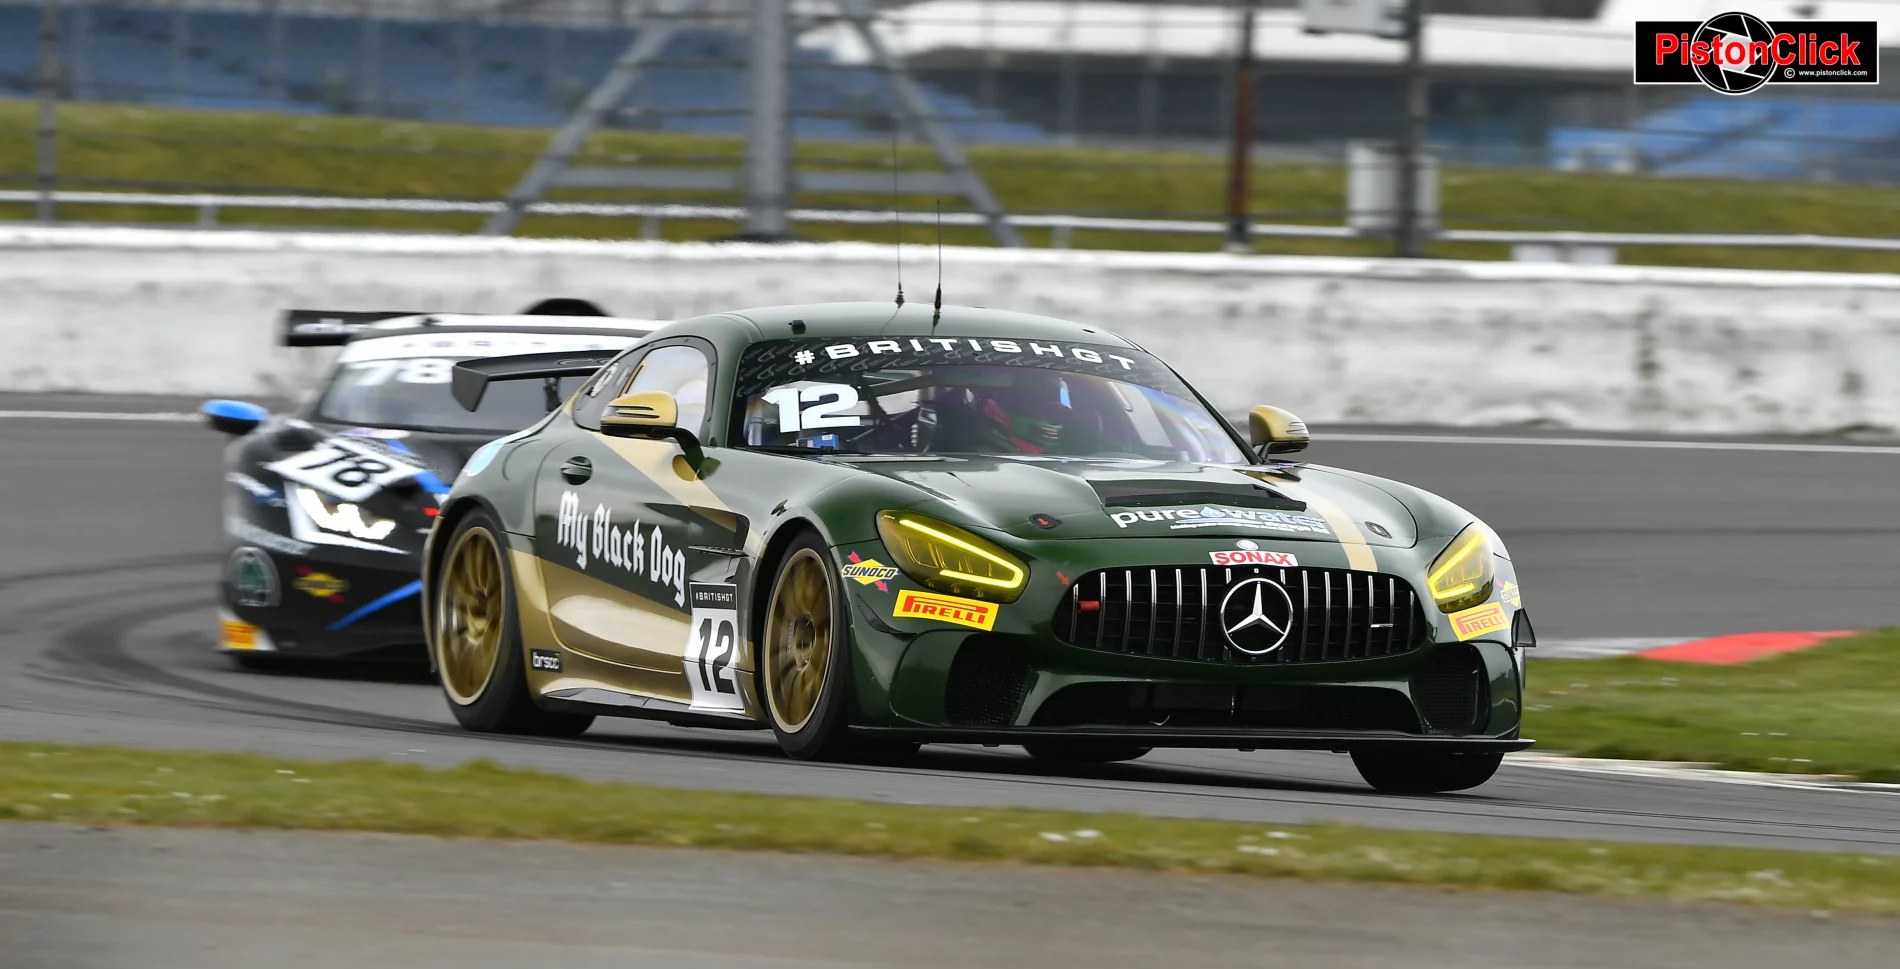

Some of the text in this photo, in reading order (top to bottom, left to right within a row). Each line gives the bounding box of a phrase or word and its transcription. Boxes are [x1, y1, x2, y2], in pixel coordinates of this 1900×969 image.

[794, 337, 1135, 370] #BRITISHGT
[351, 357, 454, 386] 78
[762, 383, 861, 434] 12
[301, 445, 392, 487] 78
[1110, 508, 1327, 529] pure water
[557, 490, 686, 608] My Black Dog
[1213, 550, 1293, 566] SONAX
[842, 565, 897, 579] SUNOCO
[695, 591, 733, 602] #BRITISHGT
[902, 595, 989, 624] PIRELLI
[1455, 607, 1506, 635] PIRELLI
[699, 618, 736, 694] 12
